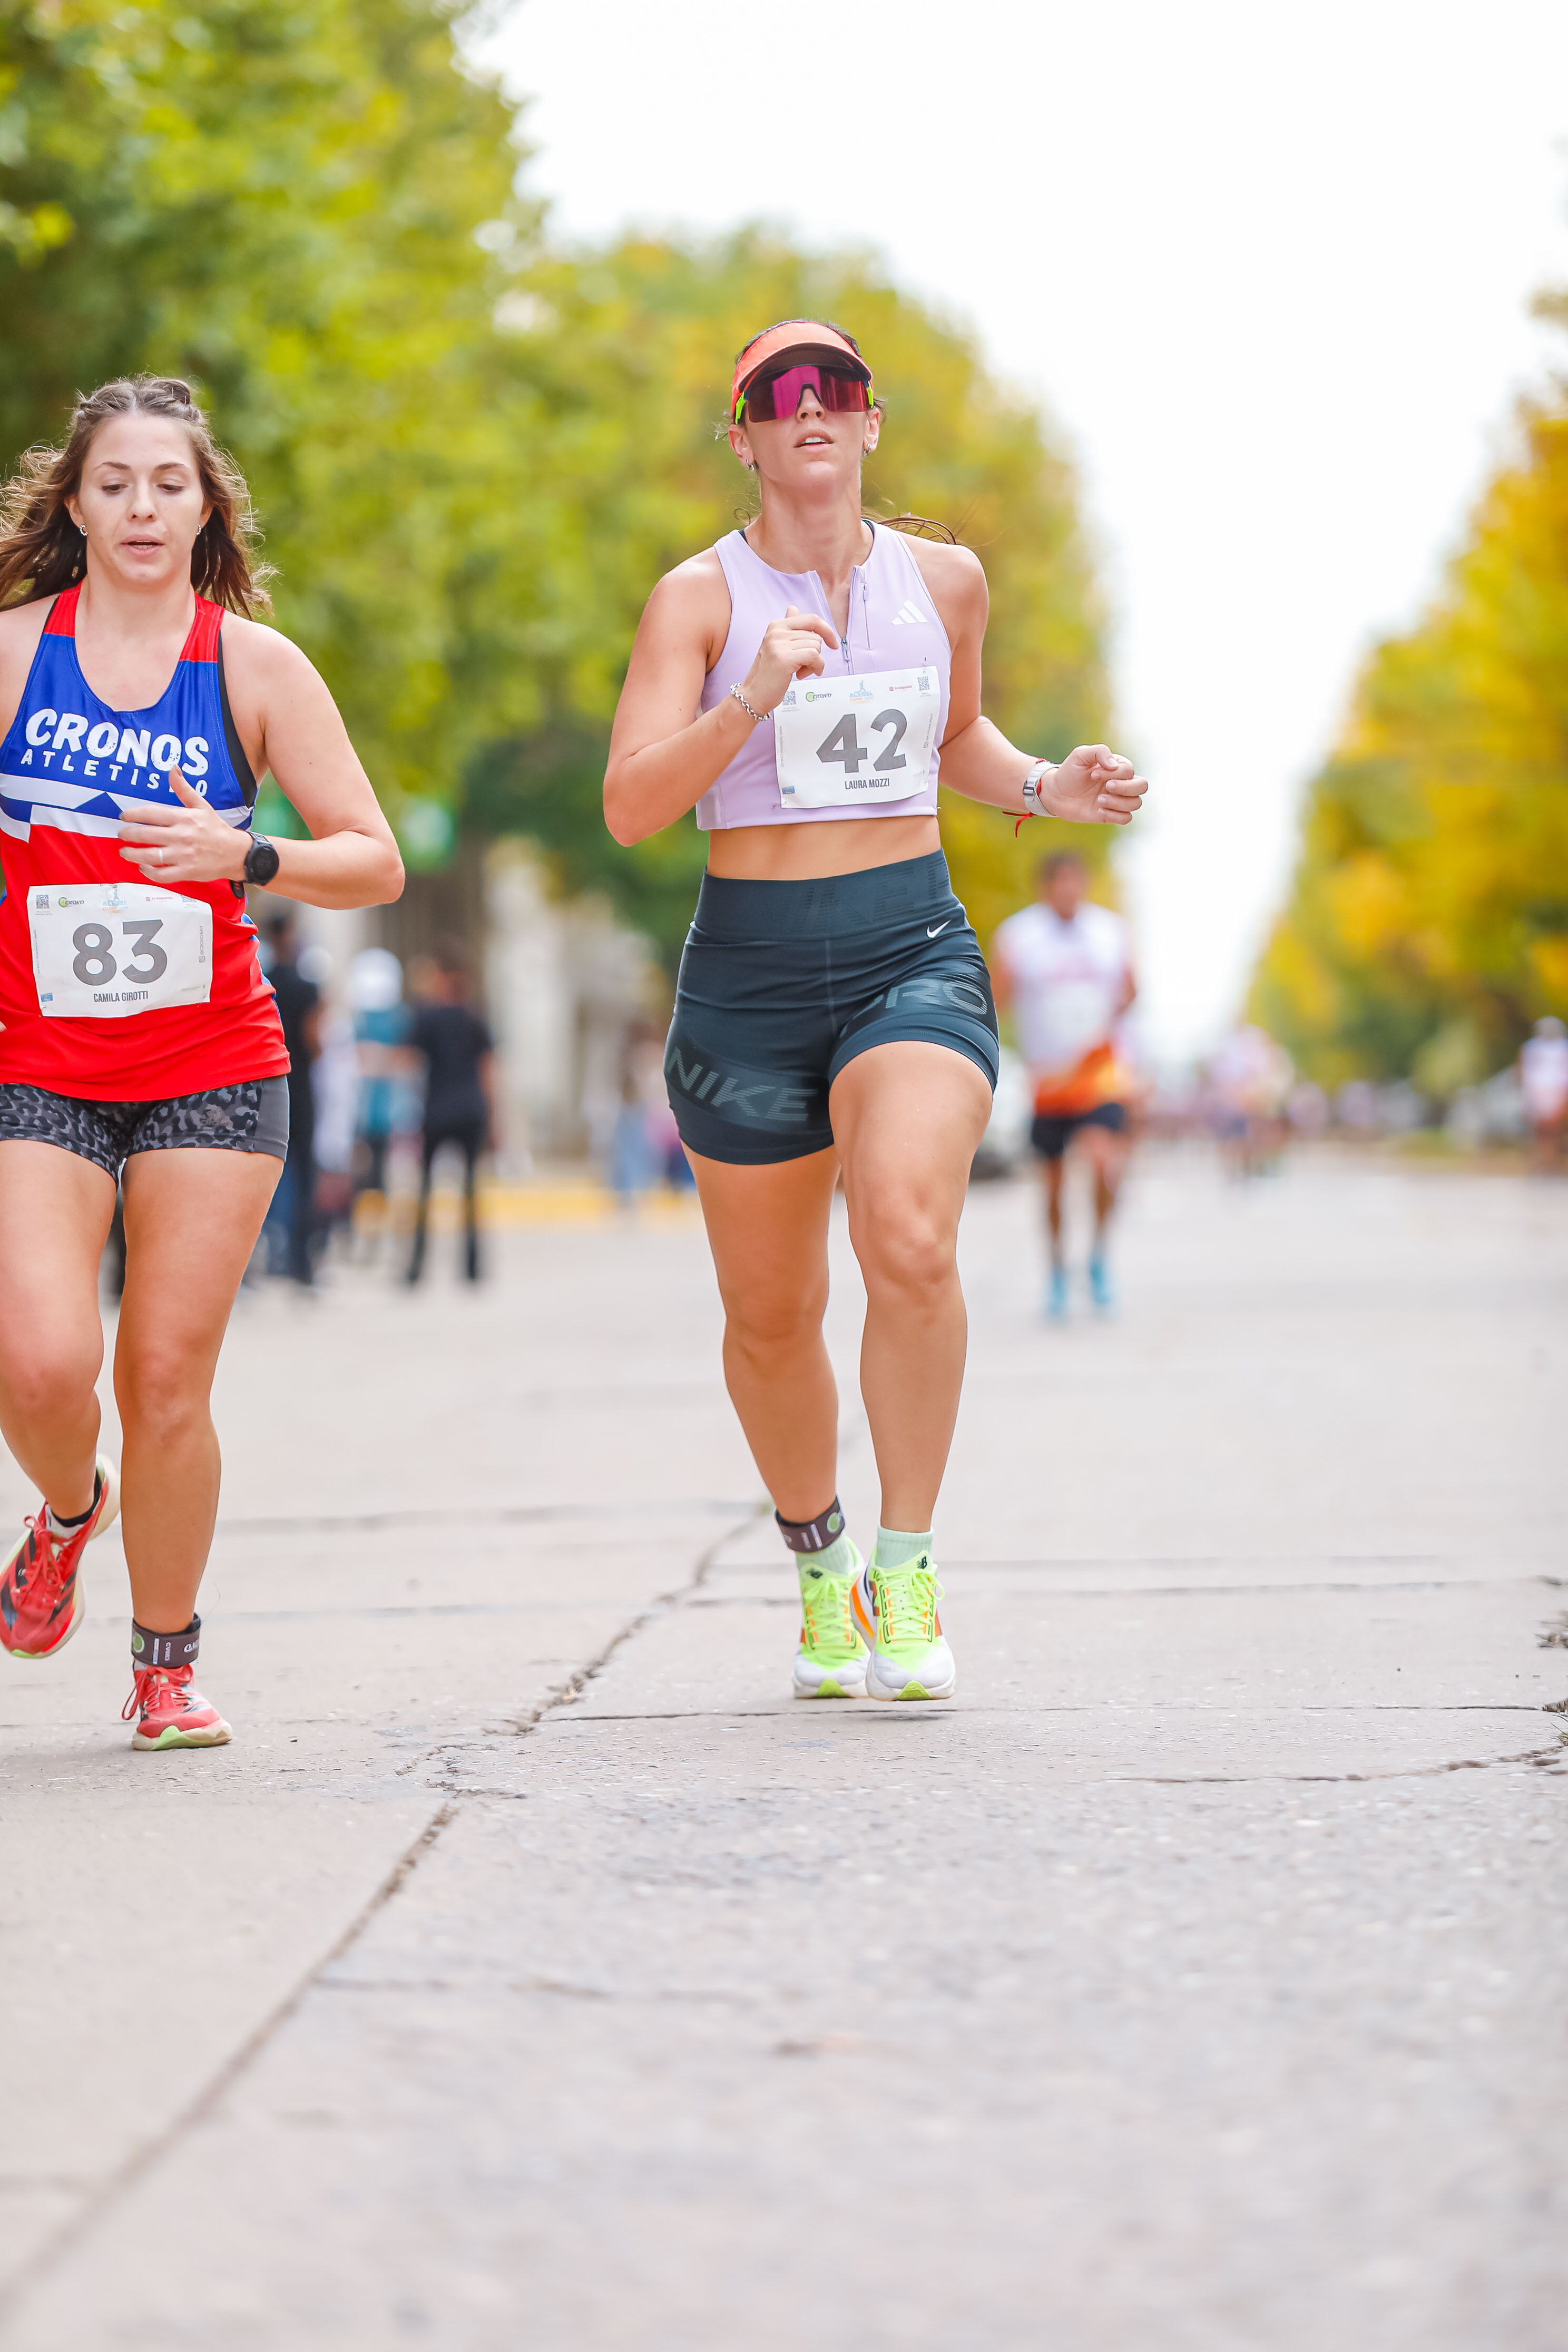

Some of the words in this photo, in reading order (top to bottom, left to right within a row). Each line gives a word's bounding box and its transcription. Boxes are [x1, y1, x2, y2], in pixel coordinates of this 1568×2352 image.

[21, 748, 208, 797] ATLETISO
[25, 708, 209, 776] CRONOS
[816, 709, 907, 773] 42
[845, 780, 867, 789] LAURA
[869, 778, 890, 788] MOZZI
[73, 919, 168, 986] 83
[93, 993, 120, 1002] CAMILA
[121, 991, 148, 1001] GIROTTI
[667, 1046, 818, 1121] NIKE
